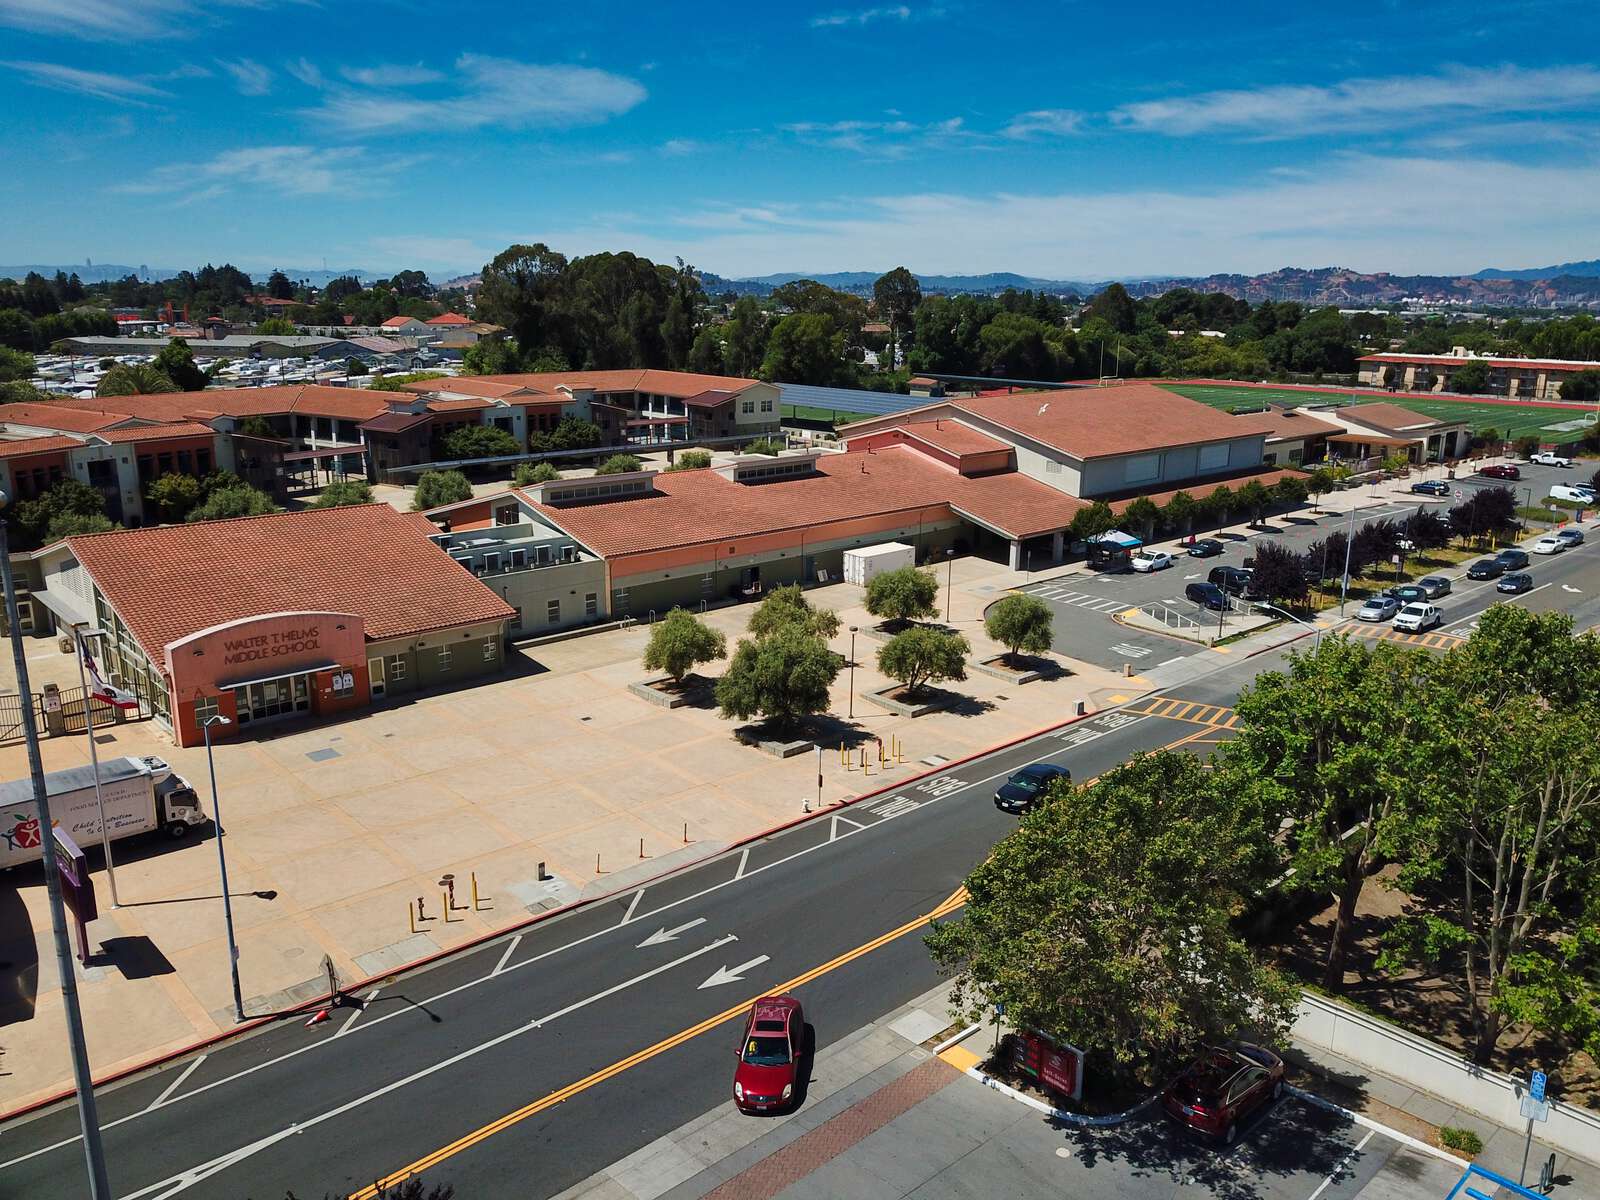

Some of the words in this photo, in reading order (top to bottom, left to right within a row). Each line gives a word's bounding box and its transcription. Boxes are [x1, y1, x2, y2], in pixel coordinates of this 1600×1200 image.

[224, 635, 269, 651] WALTER
[281, 626, 320, 642] HELMS
[224, 647, 270, 665] MIDDLE
[271, 639, 321, 657] SCHOOL
[916, 776, 969, 797] BUS
[857, 794, 921, 818] ONLY
[72, 820, 95, 833] Child
